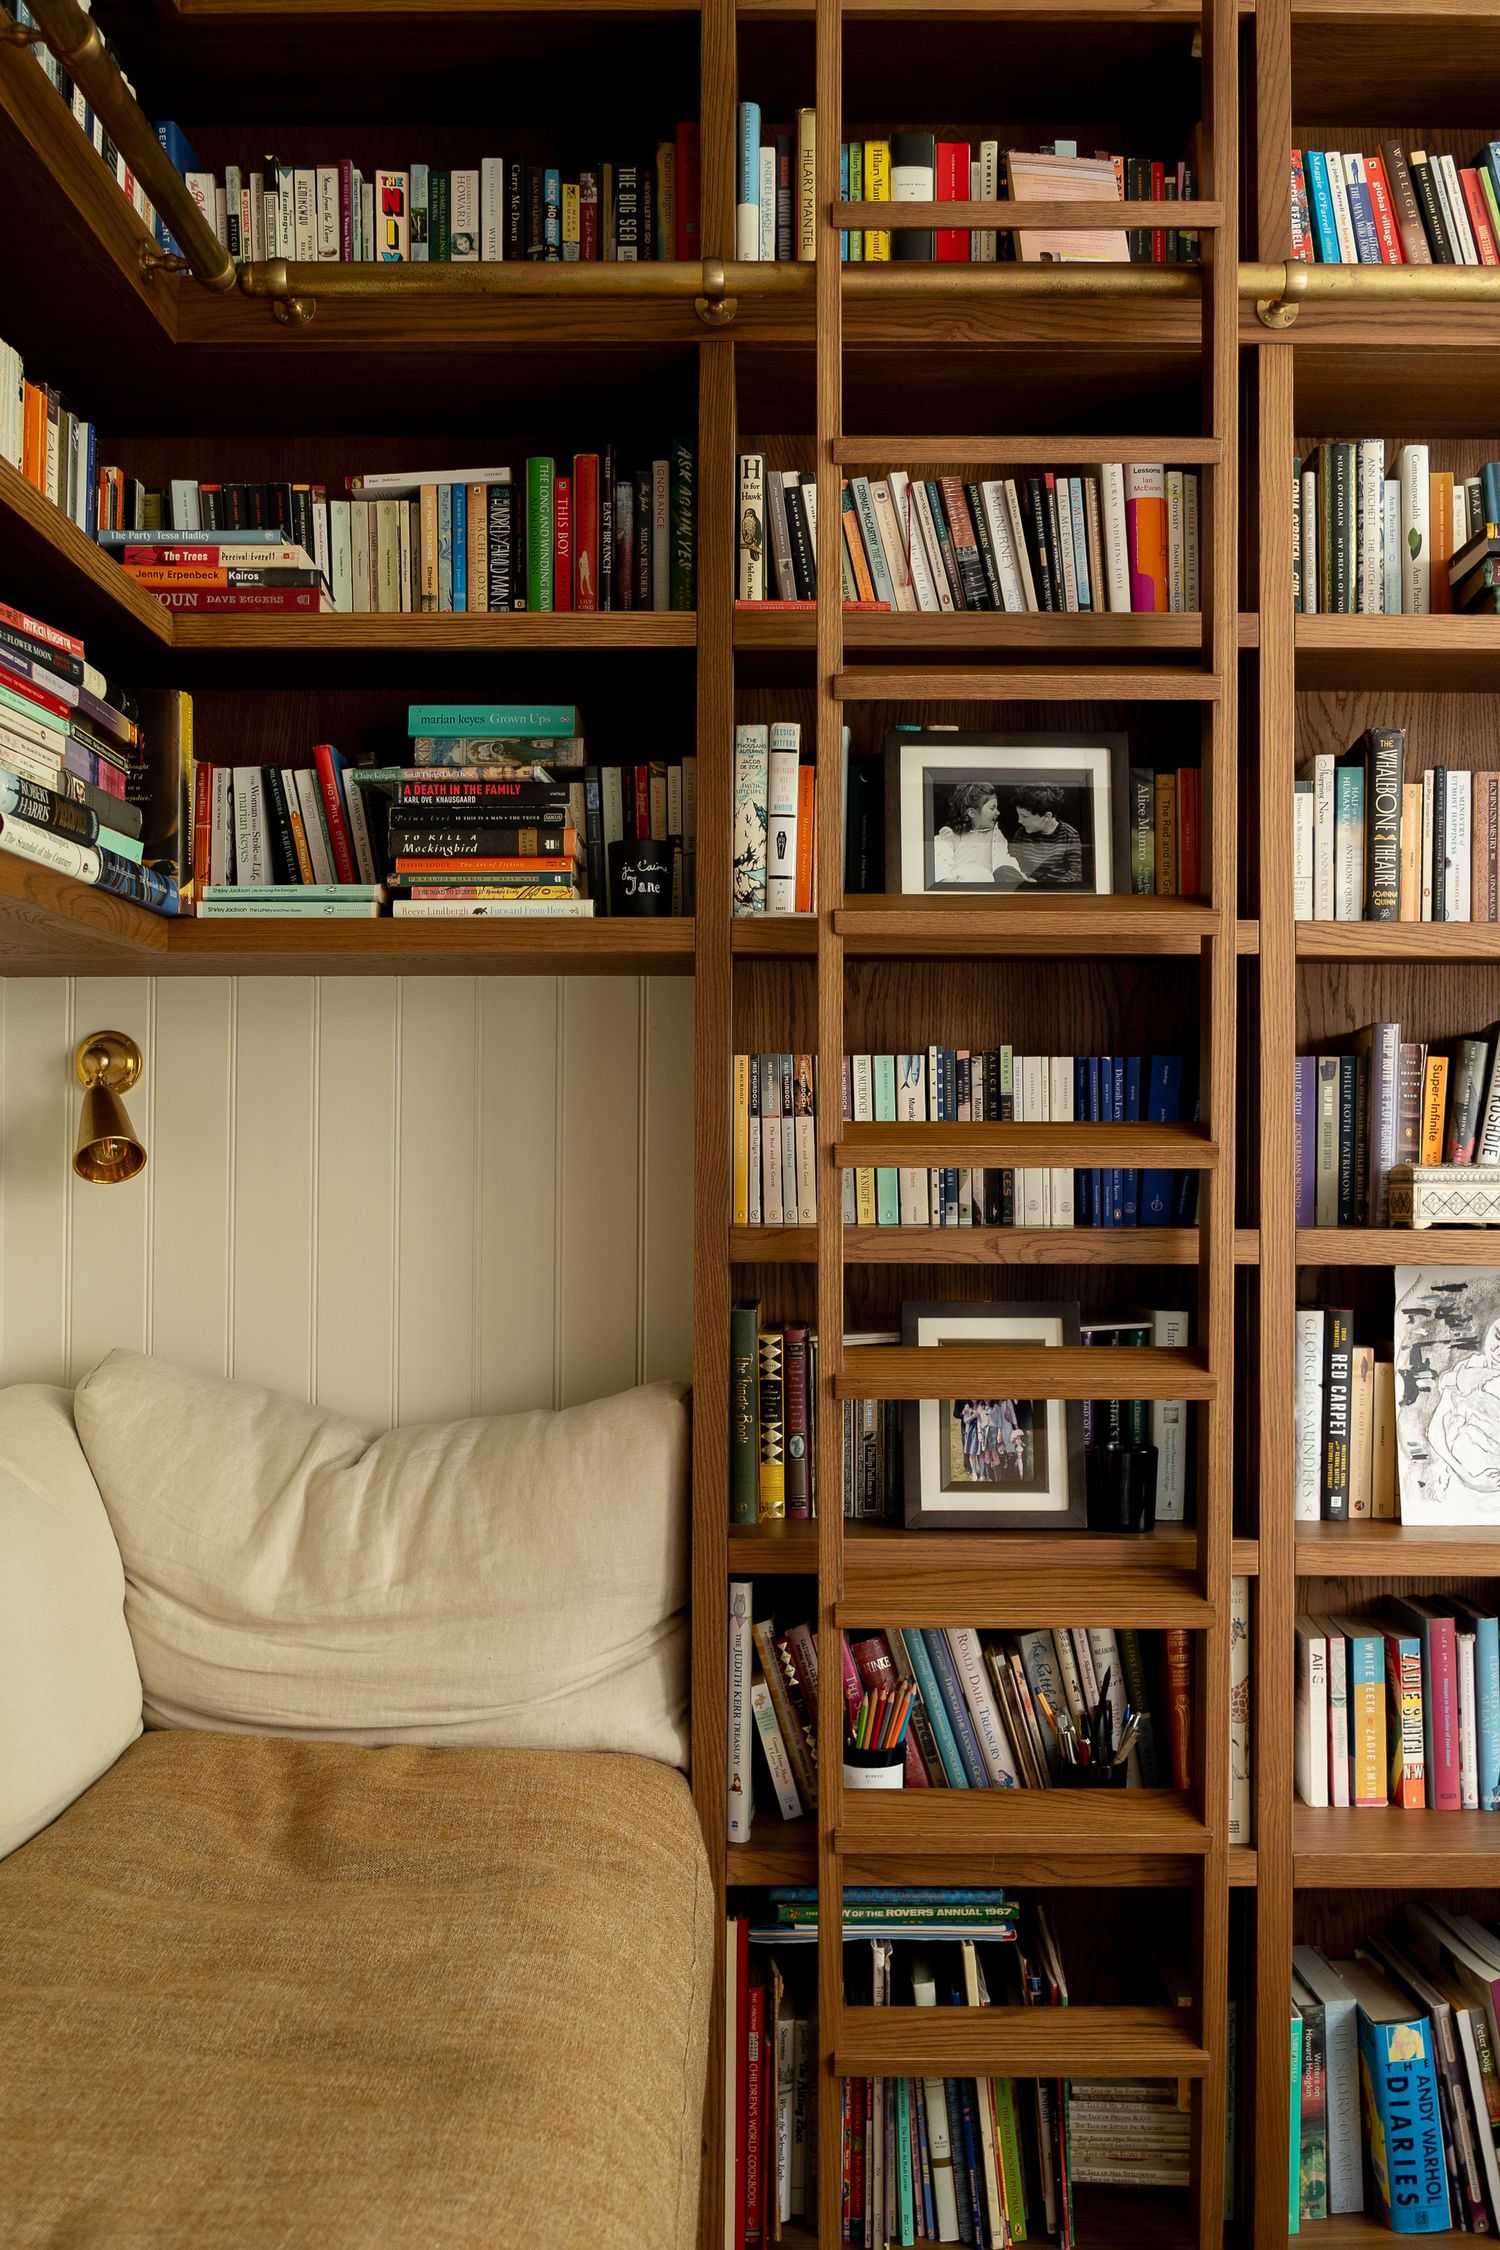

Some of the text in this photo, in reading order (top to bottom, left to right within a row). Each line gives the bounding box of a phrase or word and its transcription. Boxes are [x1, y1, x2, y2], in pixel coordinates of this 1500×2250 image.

[381, 176, 404, 187] THE
[870, 148, 885, 177] Hilary
[297, 180, 310, 228] HEMINGWAY
[456, 175, 467, 228] HOWARD
[508, 164, 521, 242] Carry Me Down
[619, 167, 637, 242] THE BIG SEA
[802, 148, 815, 251] HILARY MANTEL
[1311, 155, 1332, 235] Maggie O'Farrell
[1393, 146, 1419, 231] WARLIGHT
[1419, 167, 1444, 245] THE ENGLISH PATIENT
[281, 190, 293, 247] Hemingway
[321, 176, 337, 244] Stones from the River
[547, 178, 558, 243] NICK HORNBY
[539, 464, 549, 482] THE
[677, 445, 693, 483] ASK
[743, 459, 760, 480] H
[1134, 466, 1161, 474] Lessons
[539, 485, 550, 512] LONG
[656, 464, 665, 530] IGNORANCE
[741, 491, 762, 501] Hawk
[750, 482, 760, 490] for
[1410, 454, 1421, 521] Commonwealth
[1471, 489, 1481, 515] MAX
[111, 531, 211, 543] The Party Tessa Hadley
[539, 513, 550, 537] AND
[557, 497, 569, 558] THIS BOY
[603, 501, 612, 575] EAST BRANCH
[856, 484, 885, 579] CORMAC McCARTHY THE ROAD
[969, 485, 1001, 606] JOHN McGAHERN Amongst Women
[1336, 455, 1345, 613] NUALA O'FAOLAIN MY DREAM OF YOU
[135, 569, 260, 581] Jenny Erpenbeck Kairos
[164, 550, 209, 562] The Trees
[221, 551, 276, 562] Percival Everett
[539, 539, 551, 587] WINDING
[677, 539, 692, 571] YES
[206, 595, 285, 604] DAVE EGGERS
[490, 574, 510, 605] MAN
[420, 713, 552, 727] marian keyes Grown Ups
[420, 737, 431, 763] KIM
[1380, 740, 1394, 748] THE
[18, 797, 52, 823] HARRIS
[20, 778, 50, 805] ROBERT
[250, 785, 261, 818] Woman
[325, 783, 340, 825] HOT MILK
[403, 795, 476, 804] KARL OVE KNAUSGAARD
[404, 783, 522, 796] A DEATH IN THE FAMILY
[238, 792, 251, 864] marian keyes
[1374, 749, 1398, 887] WHALEBONE THEATRE
[281, 830, 294, 874] FAREWELL
[402, 842, 479, 857] Mockingbird
[212, 886, 251, 896] Shirley Jackson
[625, 875, 661, 896] Jane
[1373, 890, 1398, 899] JOANNA
[1374, 899, 1397, 907] QUINN
[207, 905, 247, 914] Shirley Jackson
[402, 903, 566, 919] Reeve Lindbergh Forward From Here
[1428, 1063, 1444, 1142] Super-Infinite
[1342, 1064, 1352, 1202] PHILIP ROTH PATRIMONY
[734, 1353, 754, 1444] The Jungle Book
[1302, 1318, 1318, 1498] GEORGE SAUNDERS
[1329, 1353, 1348, 1437] RED CARPET
[733, 1633, 744, 1767] THE JUDITH KERR TREASURY
[956, 1634, 1002, 1762] ROALD DAHL TREASURY
[1401, 1652, 1422, 1755] ZADIE SMITH
[1365, 1643, 1377, 1800] WHITE TEETH ZADIE SMITH
[851, 1903, 1013, 1918] OF THE ROVERS ANNUAL 1967
[1385, 2059, 1430, 2073] THE
[1477, 2023, 1491, 2074] Peter Doig
[746, 2063, 759, 2208] CHILDREN'S WORLD COOKBOOK
[1386, 2076, 1420, 2206] DIARIES
[1416, 2074, 1443, 2203] ANDY WARHOL
